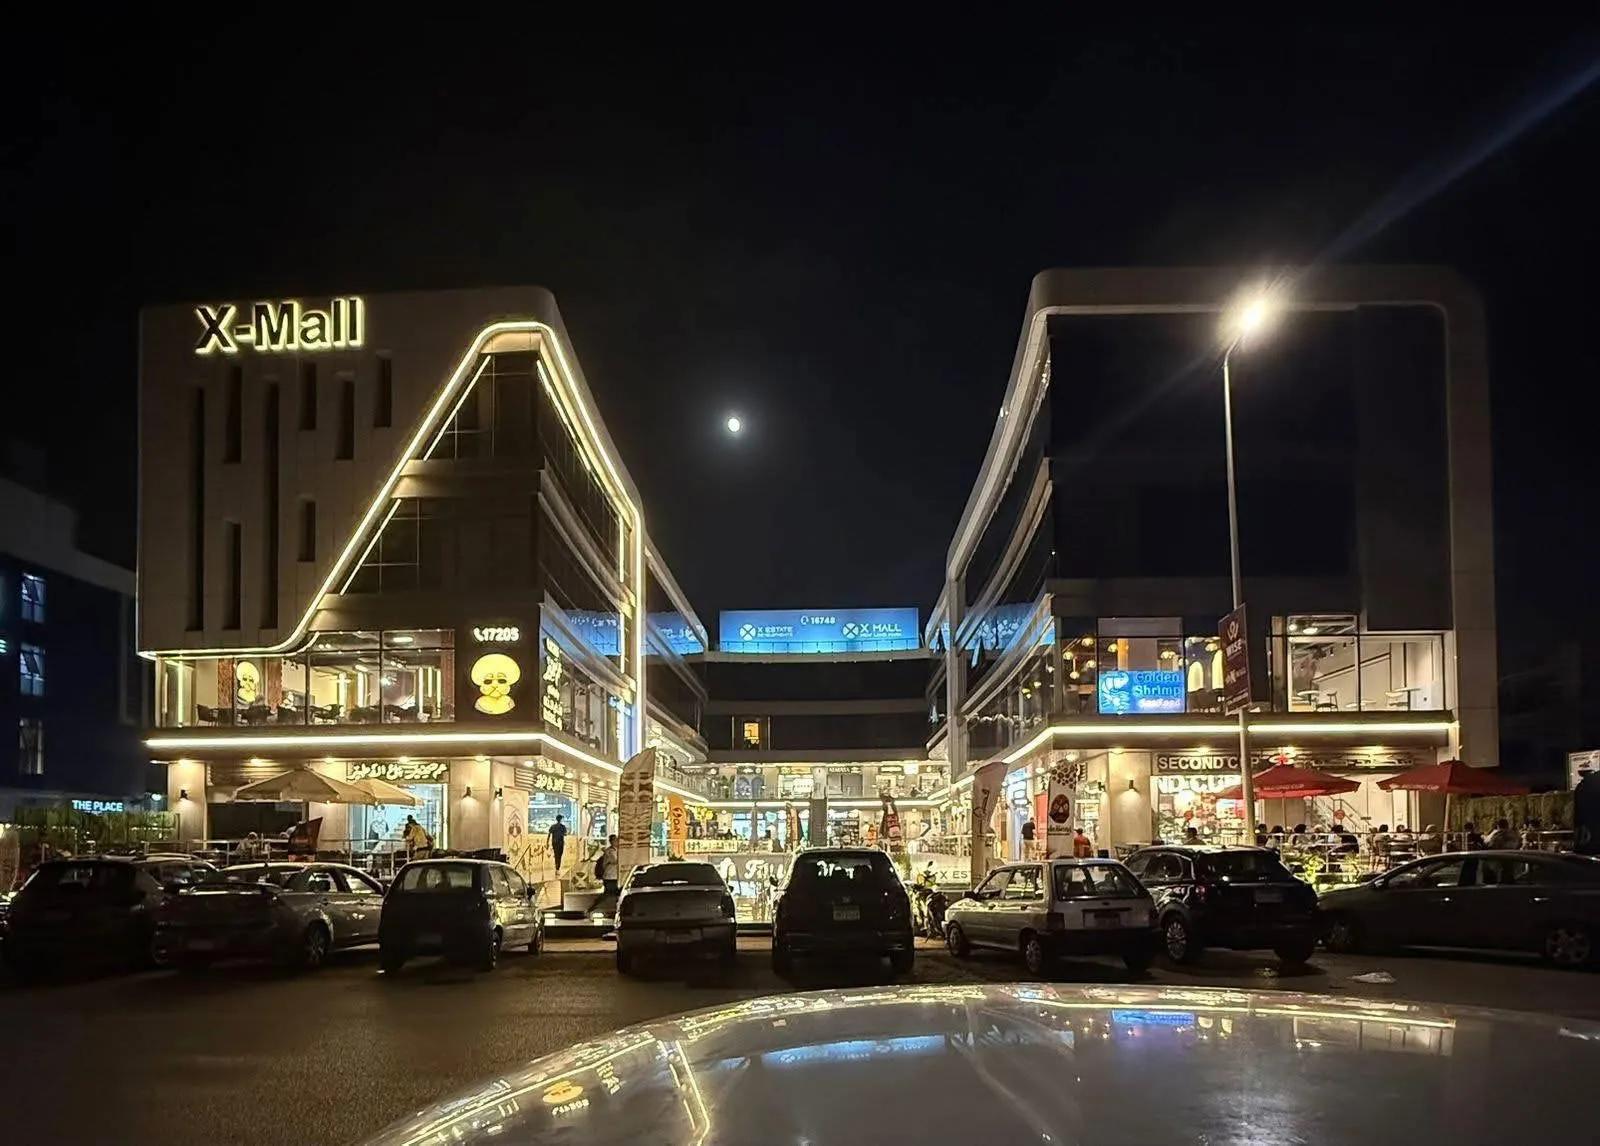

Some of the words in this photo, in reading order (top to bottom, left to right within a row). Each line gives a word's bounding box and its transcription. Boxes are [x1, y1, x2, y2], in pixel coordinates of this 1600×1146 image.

[195, 295, 365, 355] X-Mall
[860, 623, 869, 633] X
[872, 623, 902, 633] MALL
[1135, 672, 1180, 683] Golden
[1133, 685, 1182, 698] Shrimp
[1158, 756, 1224, 770] SECOND
[1227, 756, 1260, 769] CP
[72, 800, 92, 811] THE
[93, 801, 123, 812] PLACE
